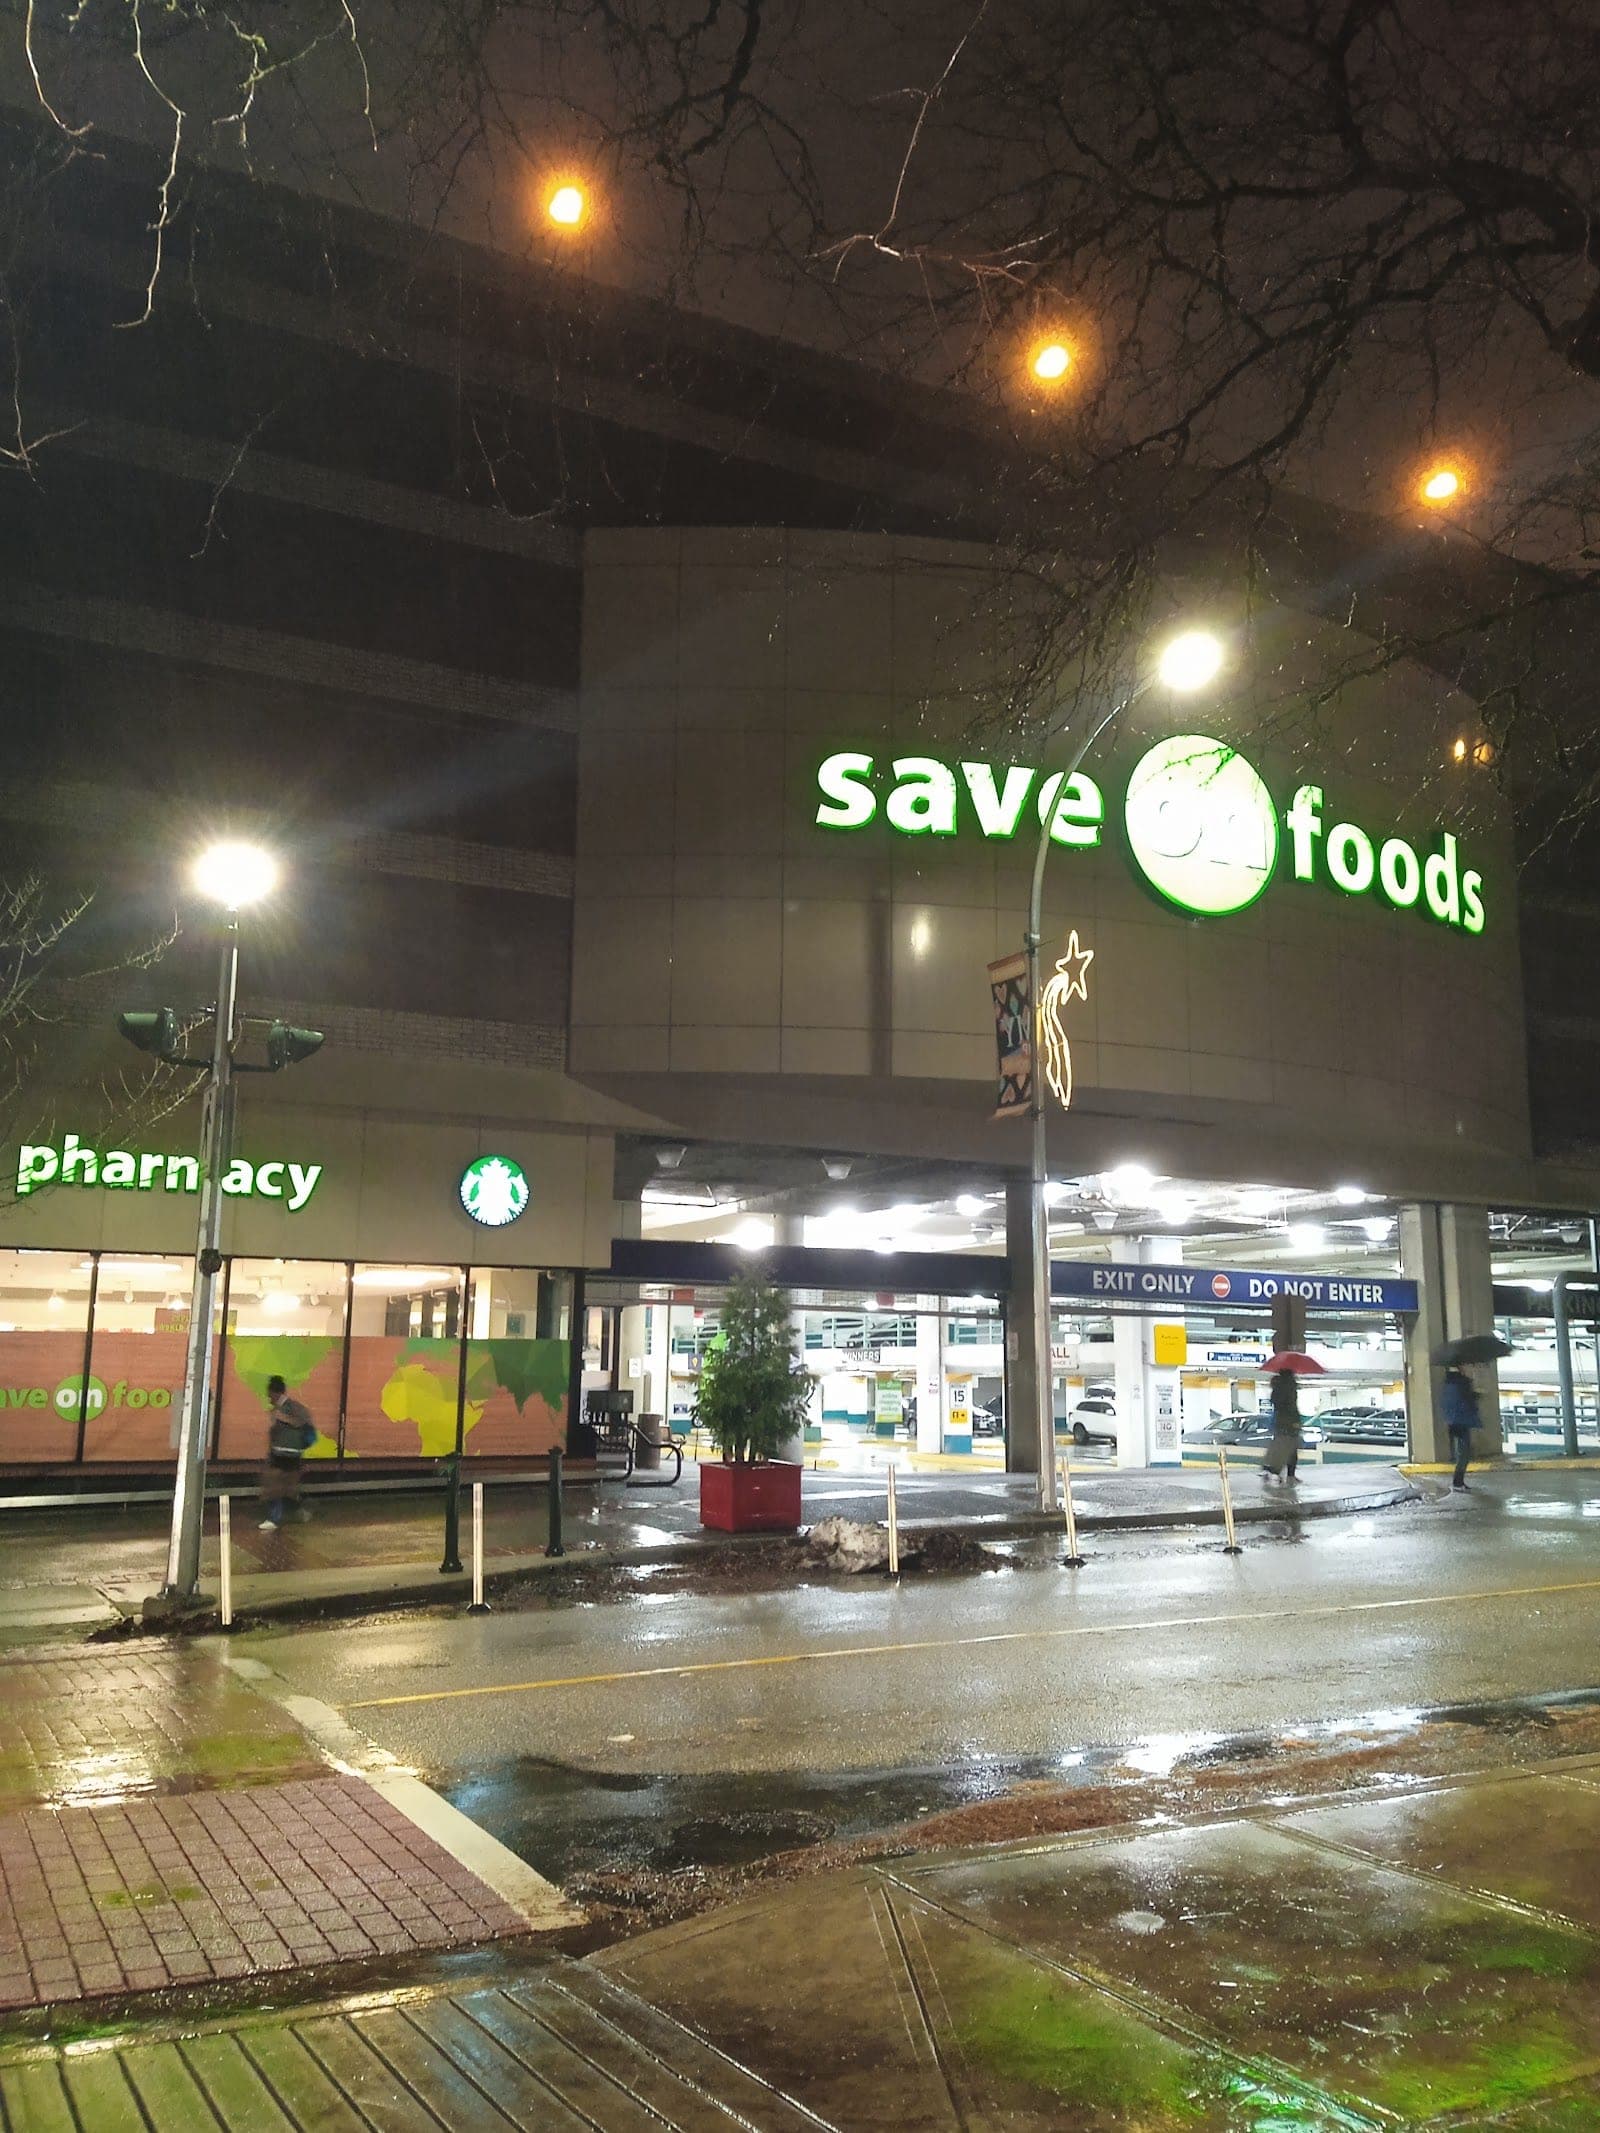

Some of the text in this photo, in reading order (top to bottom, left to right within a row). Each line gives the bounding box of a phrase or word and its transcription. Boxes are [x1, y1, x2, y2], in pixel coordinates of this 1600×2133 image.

[815, 752, 1104, 846] save
[1285, 786, 1486, 935] foods
[15, 1134, 322, 1211] pharmacy
[1092, 1270, 1384, 1303] EXIT ONLY DO NOT ENTER
[1050, 1346, 1071, 1359] ALL
[0, 1380, 173, 1408] ve on foo
[954, 1390, 965, 1403] 15
